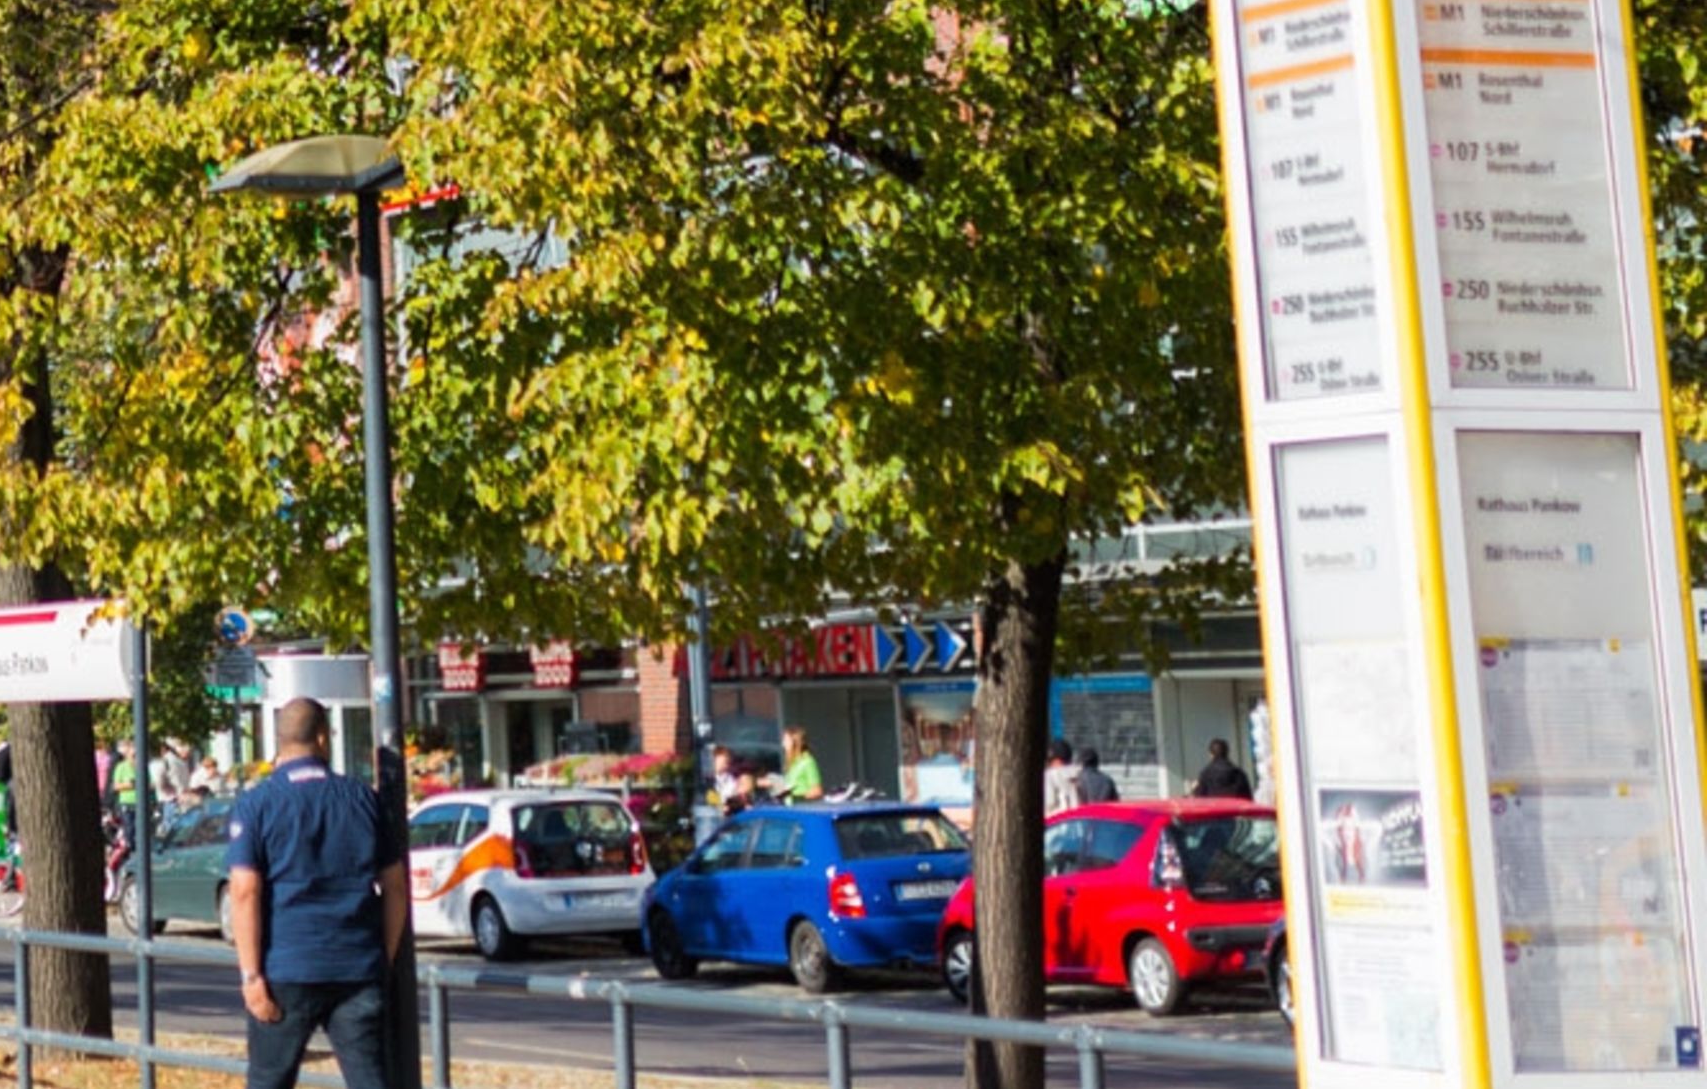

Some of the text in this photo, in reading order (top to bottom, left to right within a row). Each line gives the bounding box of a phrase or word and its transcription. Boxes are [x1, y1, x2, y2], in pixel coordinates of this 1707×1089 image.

[1439, 5, 1464, 21] M1
[1483, 23, 1572, 38] Schillerstraße
[1439, 73, 1463, 89] M1
[1478, 73, 1543, 88] Rosenthal
[1479, 91, 1512, 104] Nord
[1447, 142, 1478, 160] 107
[1271, 158, 1293, 179] 107
[1486, 161, 1555, 174] Hermsdorf
[1453, 211, 1485, 231] 155
[1275, 227, 1299, 248] 155
[1492, 228, 1586, 244] Fontanestraße
[1457, 280, 1490, 300] 250
[1280, 294, 1305, 315] 250
[1498, 298, 1571, 315] Buchholzer
[1464, 351, 1499, 371] 255
[1291, 363, 1315, 384] 255
[1478, 497, 1581, 514] Rathaus Pankow
